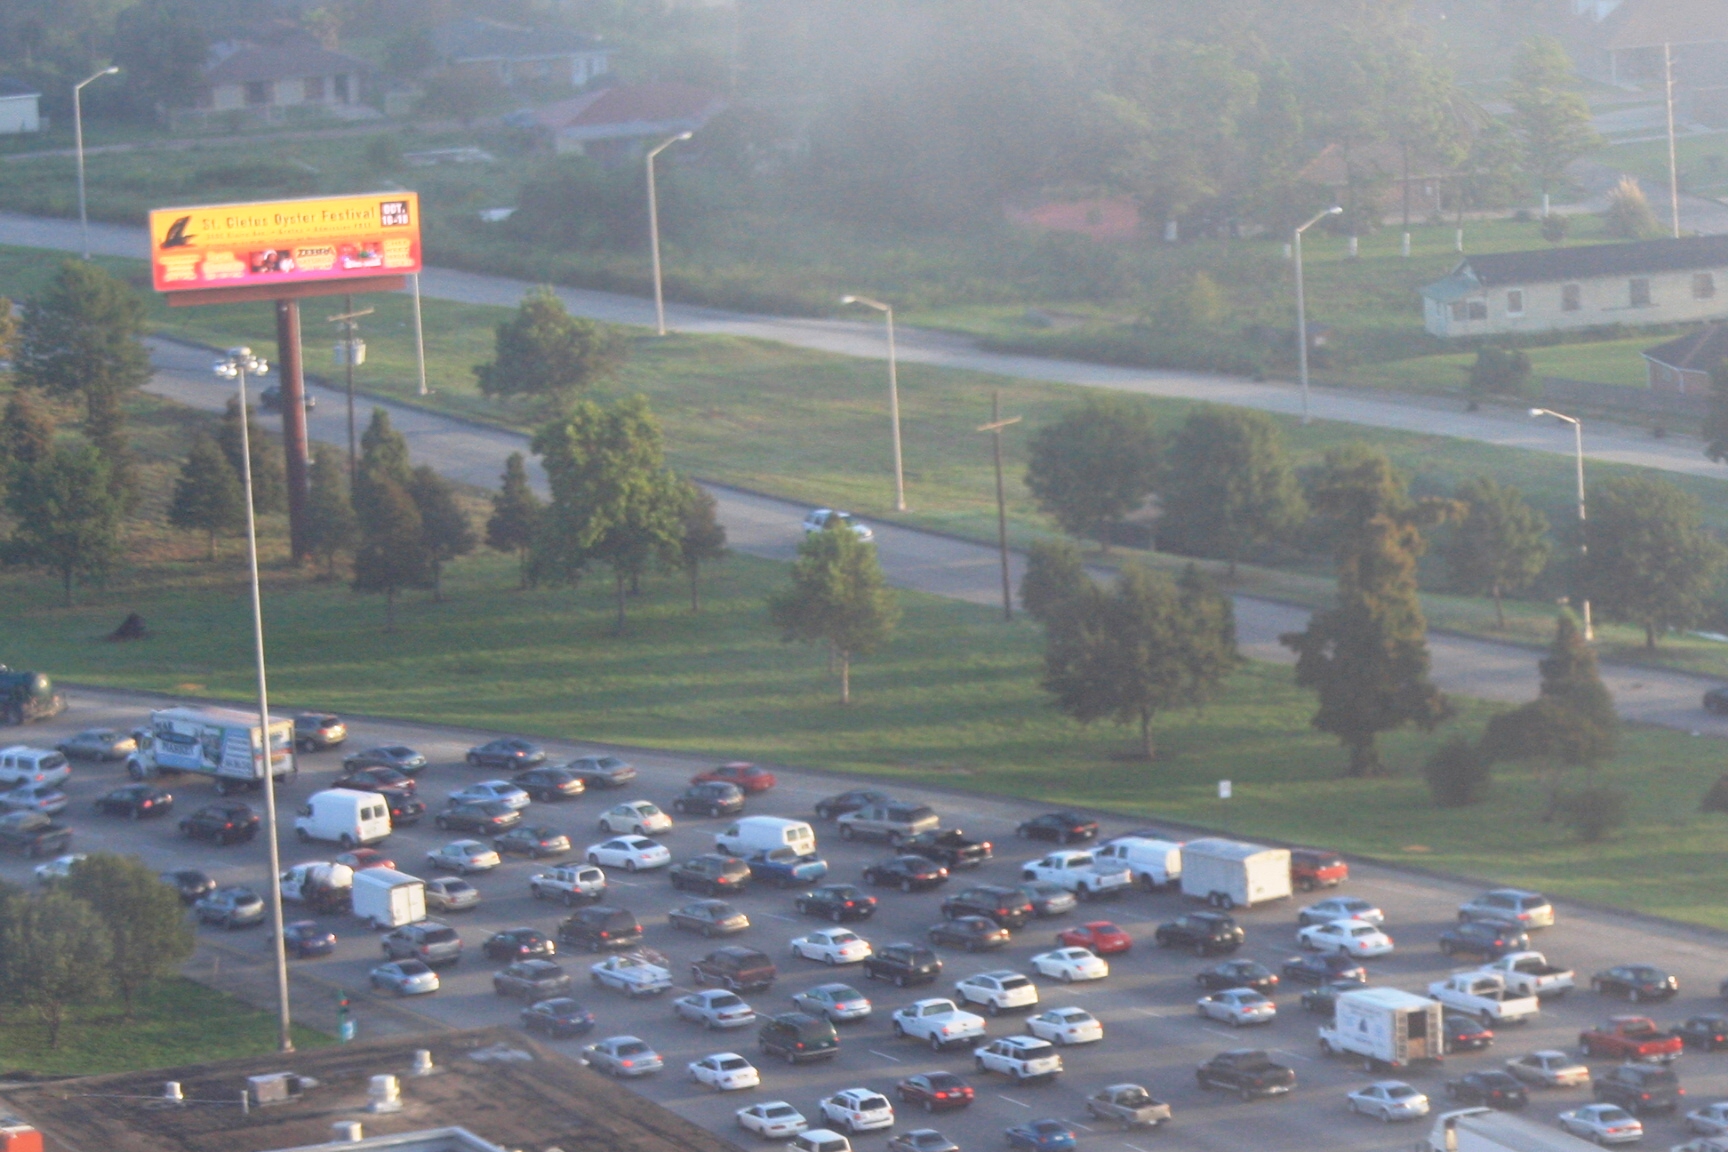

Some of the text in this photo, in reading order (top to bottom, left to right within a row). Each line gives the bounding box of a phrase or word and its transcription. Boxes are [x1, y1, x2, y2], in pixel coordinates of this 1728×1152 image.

[382, 203, 406, 214] OCT.
[203, 207, 375, 230] St. Cletus Oyster Festival
